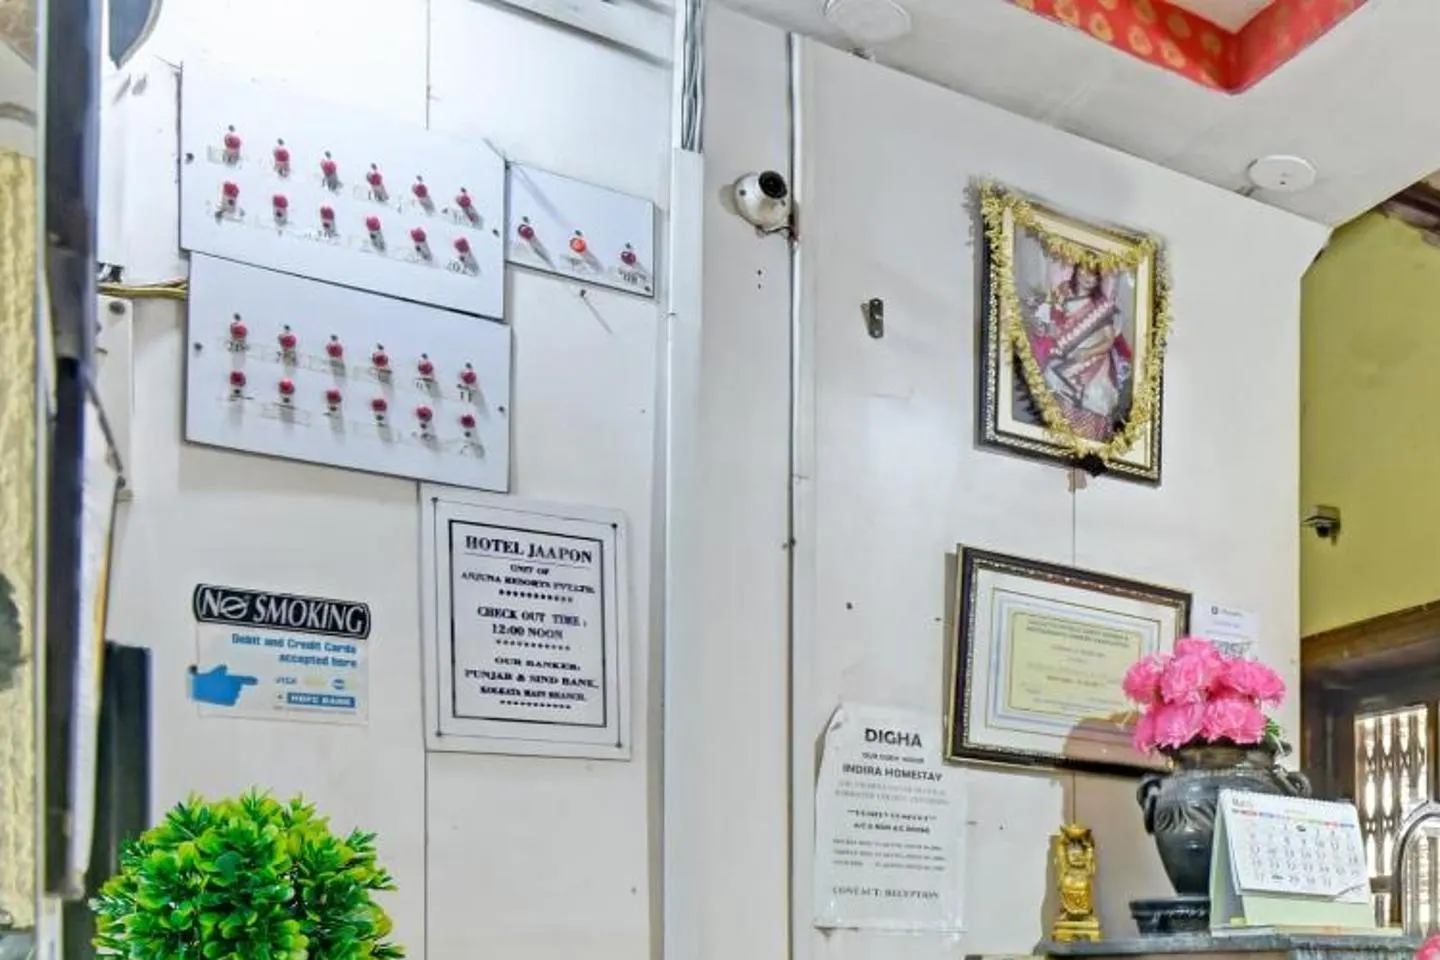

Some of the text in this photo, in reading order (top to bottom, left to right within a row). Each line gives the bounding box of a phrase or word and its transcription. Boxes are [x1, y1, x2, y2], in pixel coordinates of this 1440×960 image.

[465, 535, 593, 563] HOTEL JAAPON
[253, 596, 364, 633] SMOKING
[477, 606, 517, 620] CHECK
[521, 611, 546, 622] OUT
[492, 623, 563, 639] 12:00 NOON
[231, 632, 357, 654] Debit and Credit Cards
[331, 657, 358, 668] here
[494, 656, 521, 666] OUR
[464, 668, 513, 681] PUNJAB
[516, 674, 526, 682] &
[529, 675, 560, 684] SIND
[864, 728, 922, 748] DIGHA
[842, 763, 943, 782] INDIRA HOMESTAY
